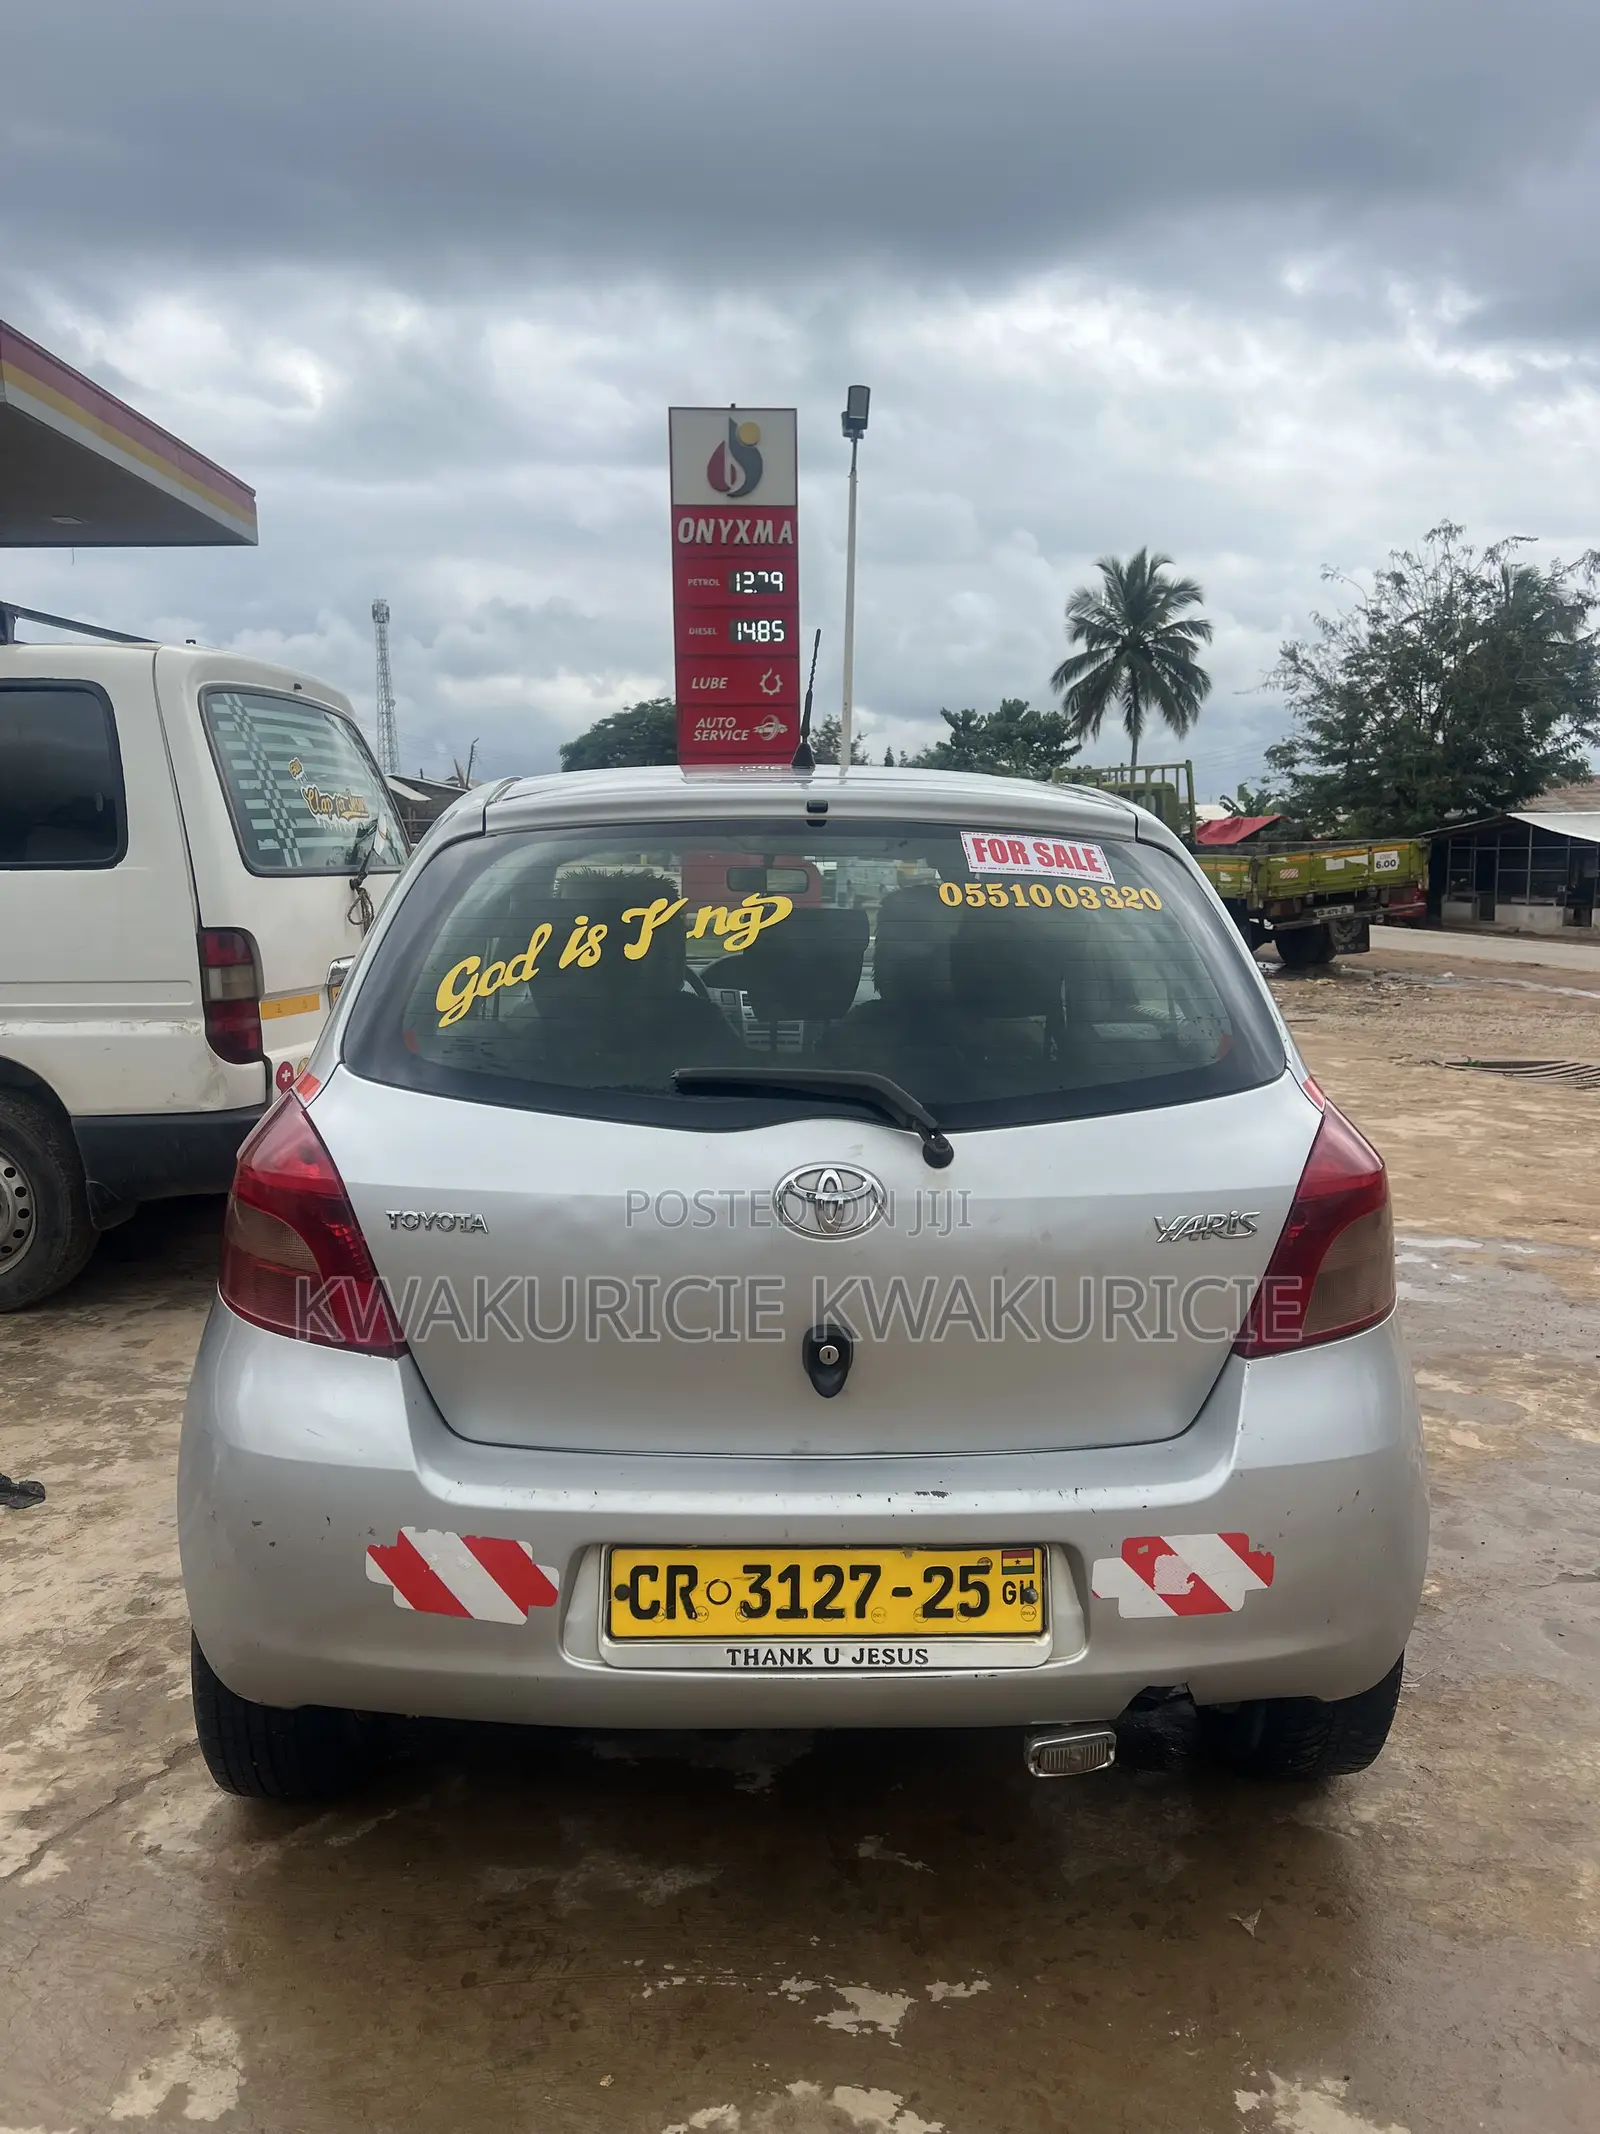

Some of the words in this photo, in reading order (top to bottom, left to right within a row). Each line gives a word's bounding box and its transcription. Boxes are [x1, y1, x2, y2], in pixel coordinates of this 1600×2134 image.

[677, 517, 793, 545] ONYXMA
[687, 578, 720, 587] PETROL
[688, 627, 718, 635] DIESEL
[691, 677, 728, 689] LUBE
[696, 717, 736, 729] AUTO
[693, 729, 750, 741] SERVICE
[971, 837, 1030, 865] FOR
[1032, 842, 1102, 872] SALE
[1376, 859, 1396, 869] 6.00
[938, 882, 1162, 910] 0551003320
[435, 923, 552, 1028] God
[559, 916, 608, 969] is
[385, 1209, 489, 1234] TOYOTA
[629, 1565, 699, 1620] CR
[726, 1648, 813, 1666] THANK
[824, 1648, 841, 1665] U
[851, 1648, 929, 1666] JESUS
